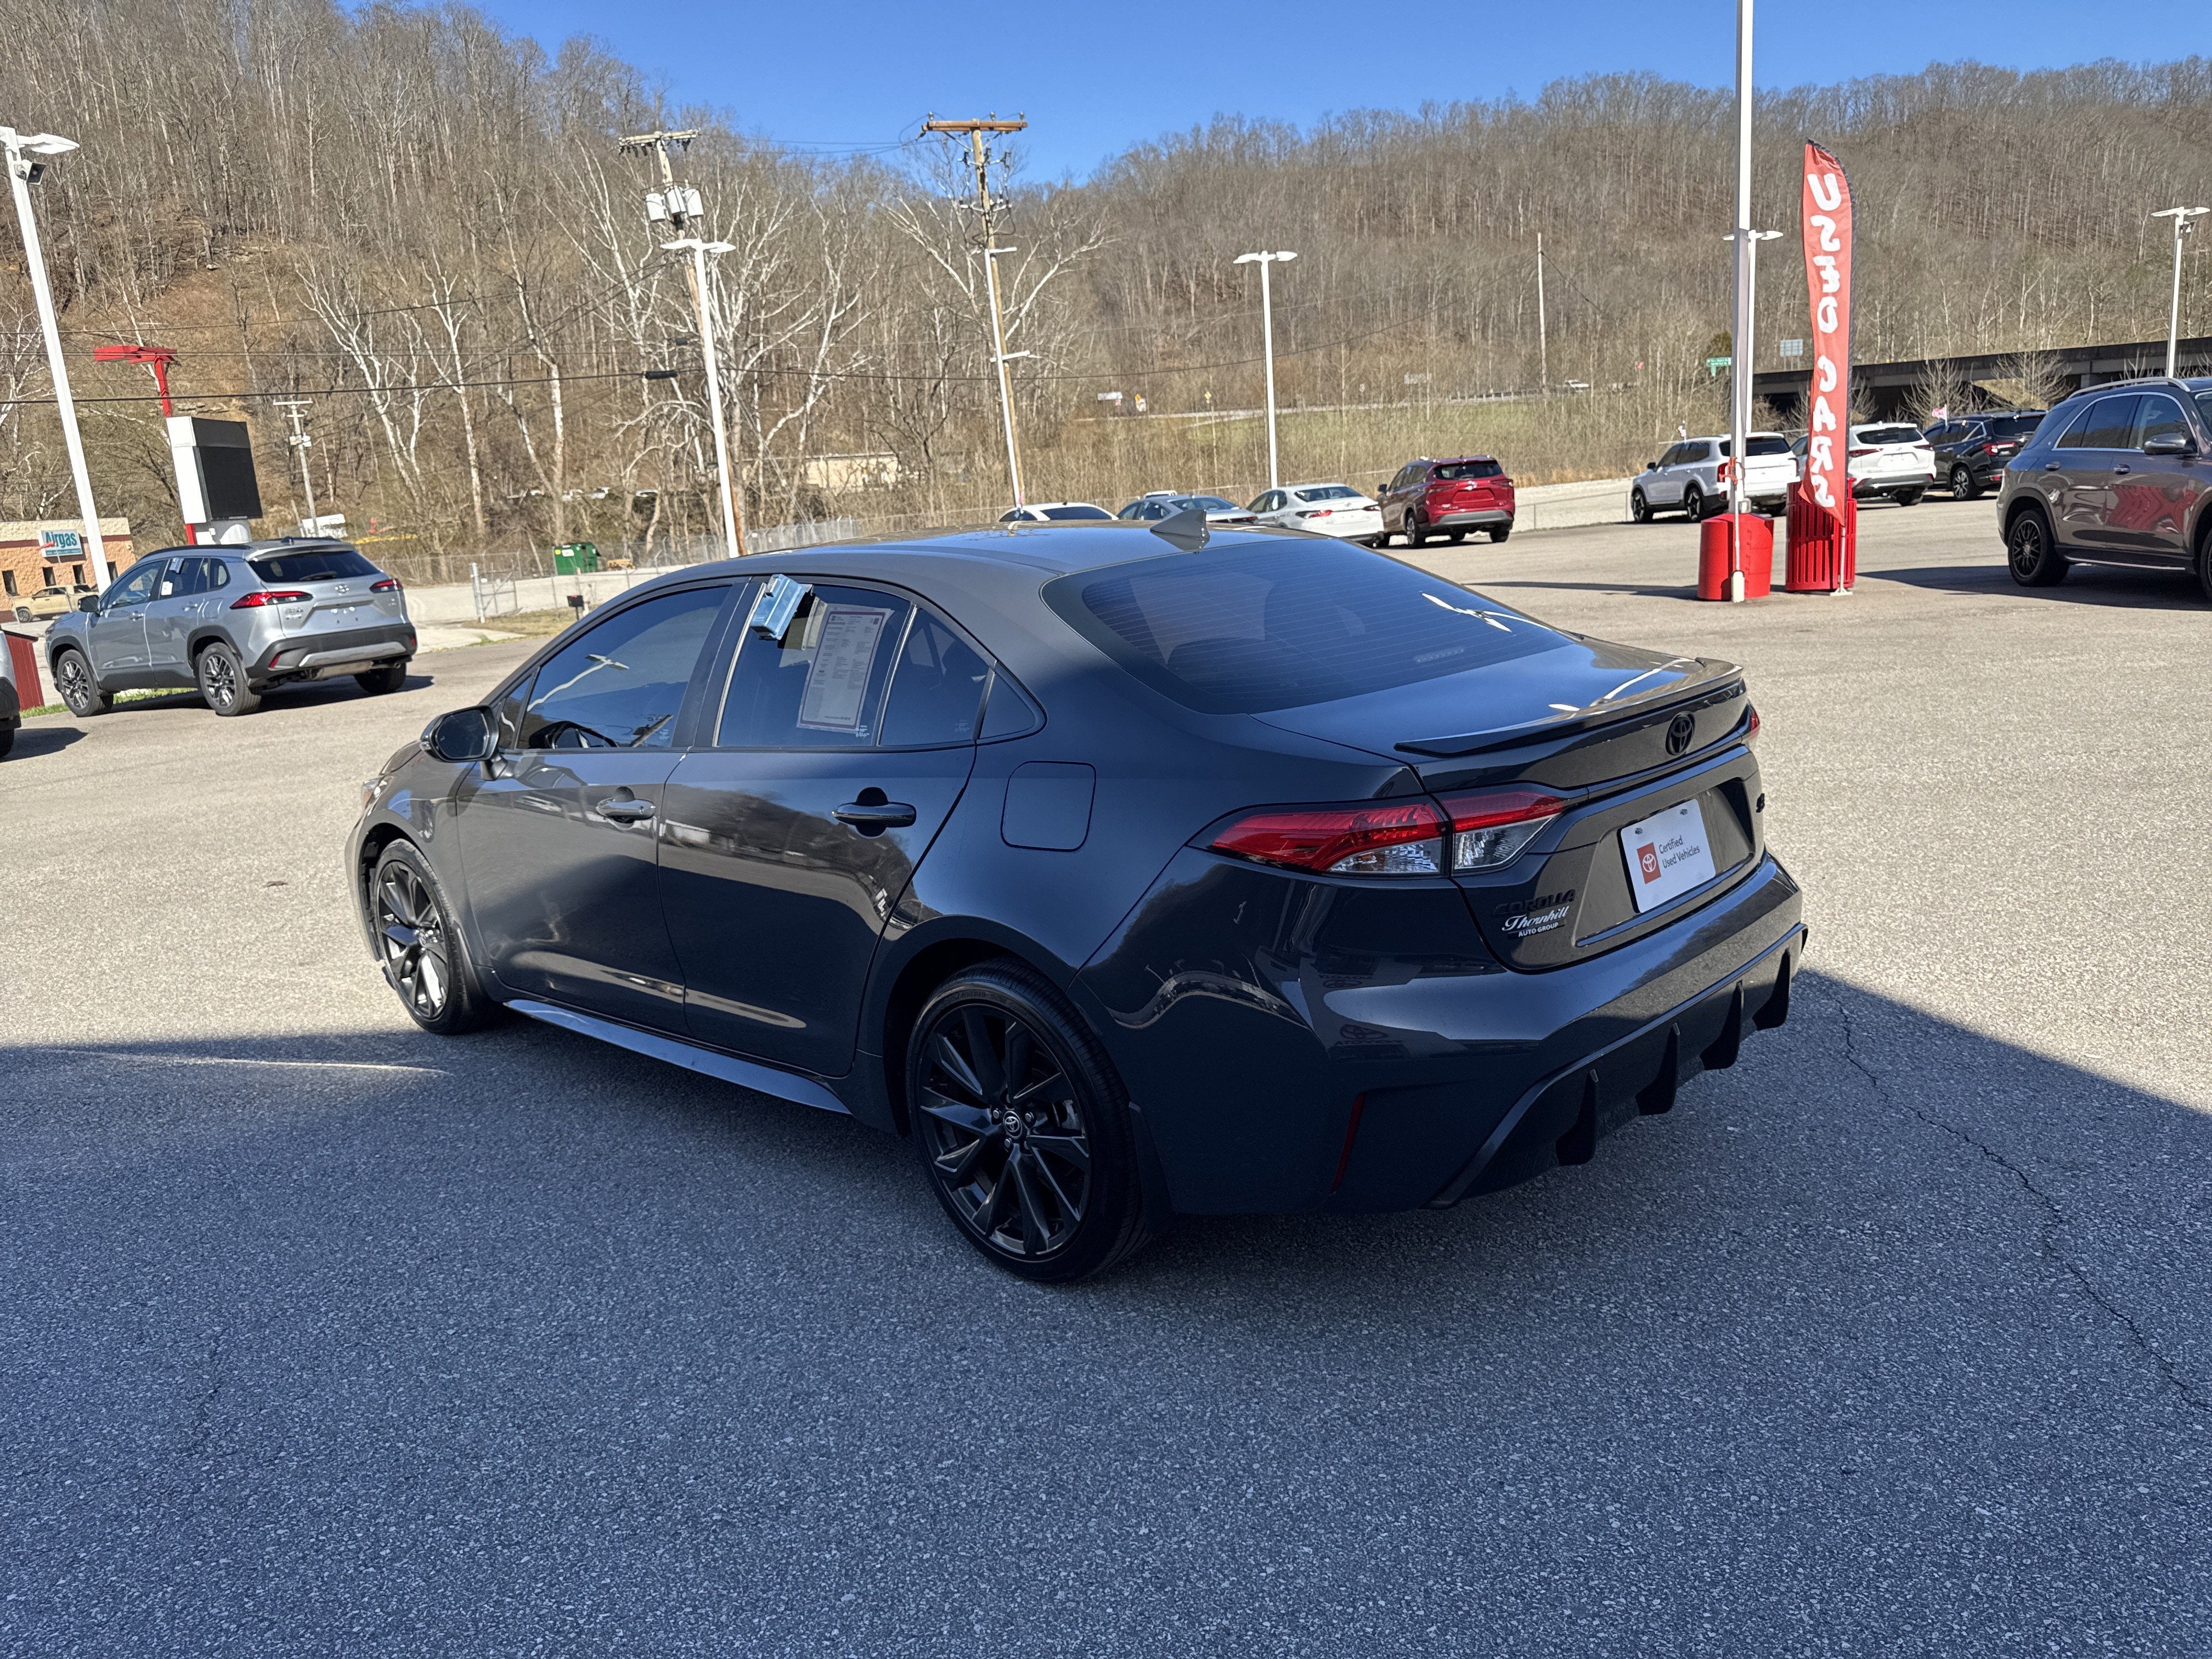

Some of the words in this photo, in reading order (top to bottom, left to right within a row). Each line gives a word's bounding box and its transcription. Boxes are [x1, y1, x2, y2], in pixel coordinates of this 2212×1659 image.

[46, 531, 77, 548] Airgas
[1658, 834, 1683, 854] Certified
[1662, 853, 1677, 869] Used
[1676, 845, 1700, 861] Vehicles
[1494, 888, 1576, 915] COROLLA
[1502, 905, 1570, 931] Thornhill
[1518, 928, 1537, 938] AUTO
[1537, 922, 1559, 933] GROUP
